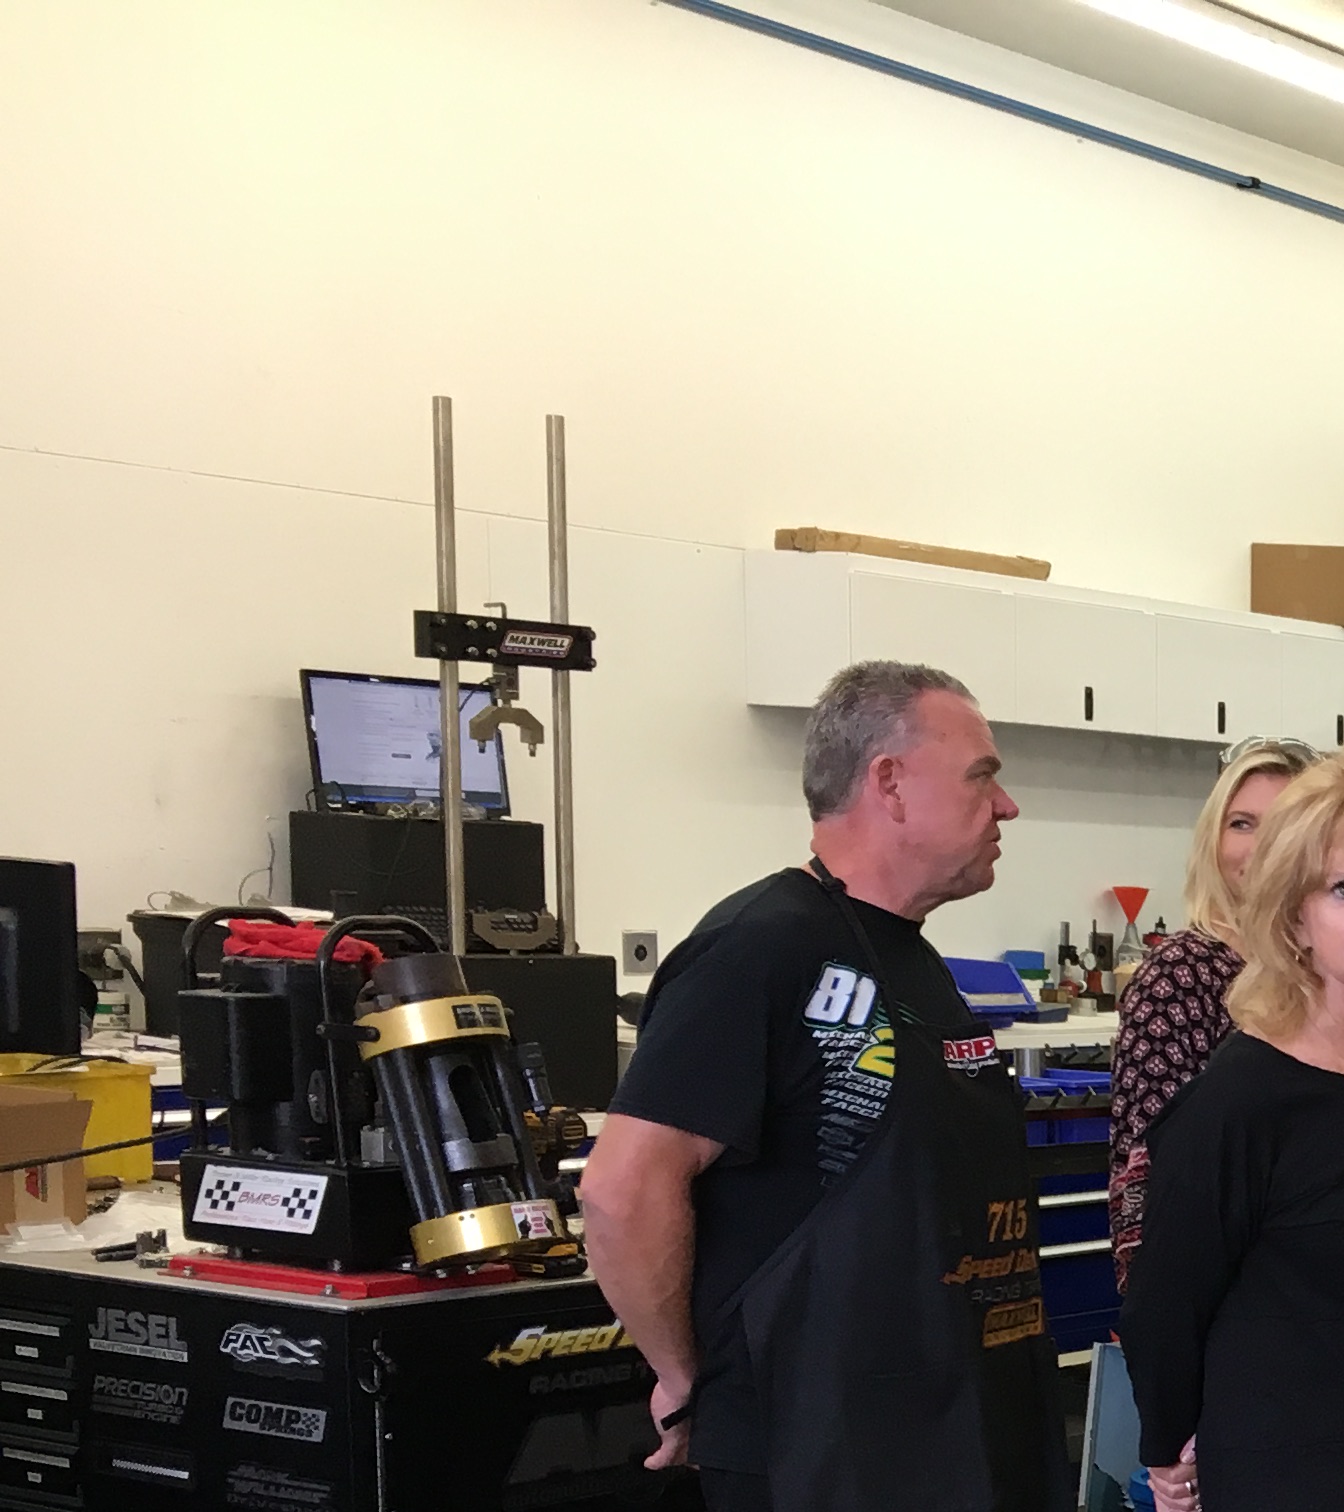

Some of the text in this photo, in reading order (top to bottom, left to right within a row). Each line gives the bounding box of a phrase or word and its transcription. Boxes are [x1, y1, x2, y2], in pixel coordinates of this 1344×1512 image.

[508, 634, 566, 648] MAXWELL
[943, 1037, 996, 1062] ARP
[237, 1191, 281, 1207] BMRS
[987, 1199, 1028, 1243] 715
[88, 1307, 188, 1350] JESEL
[220, 1330, 277, 1358] PAC
[229, 1401, 302, 1426] COMP
